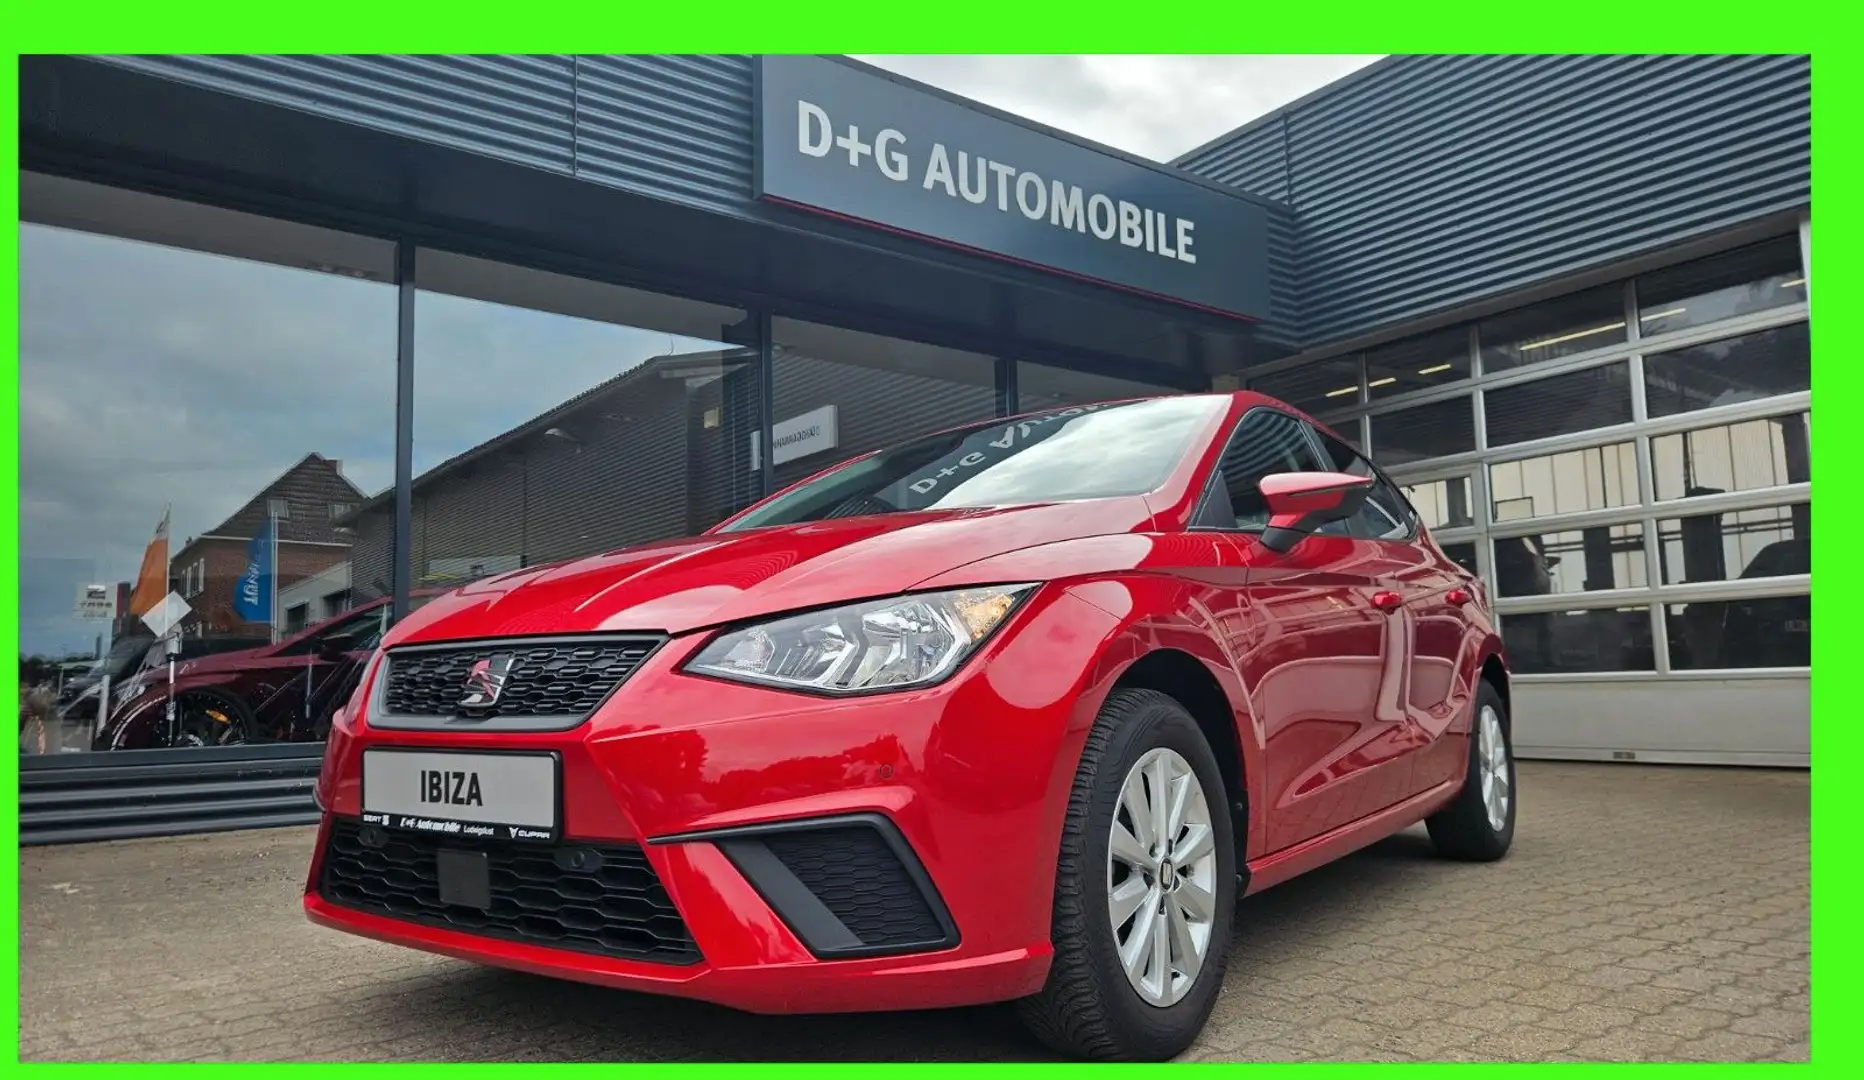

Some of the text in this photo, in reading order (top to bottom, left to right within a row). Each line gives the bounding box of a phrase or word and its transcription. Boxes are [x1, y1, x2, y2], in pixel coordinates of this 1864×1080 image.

[798, 100, 1196, 264] D+G AUTOMOBILE
[420, 770, 483, 806] IBIZA
